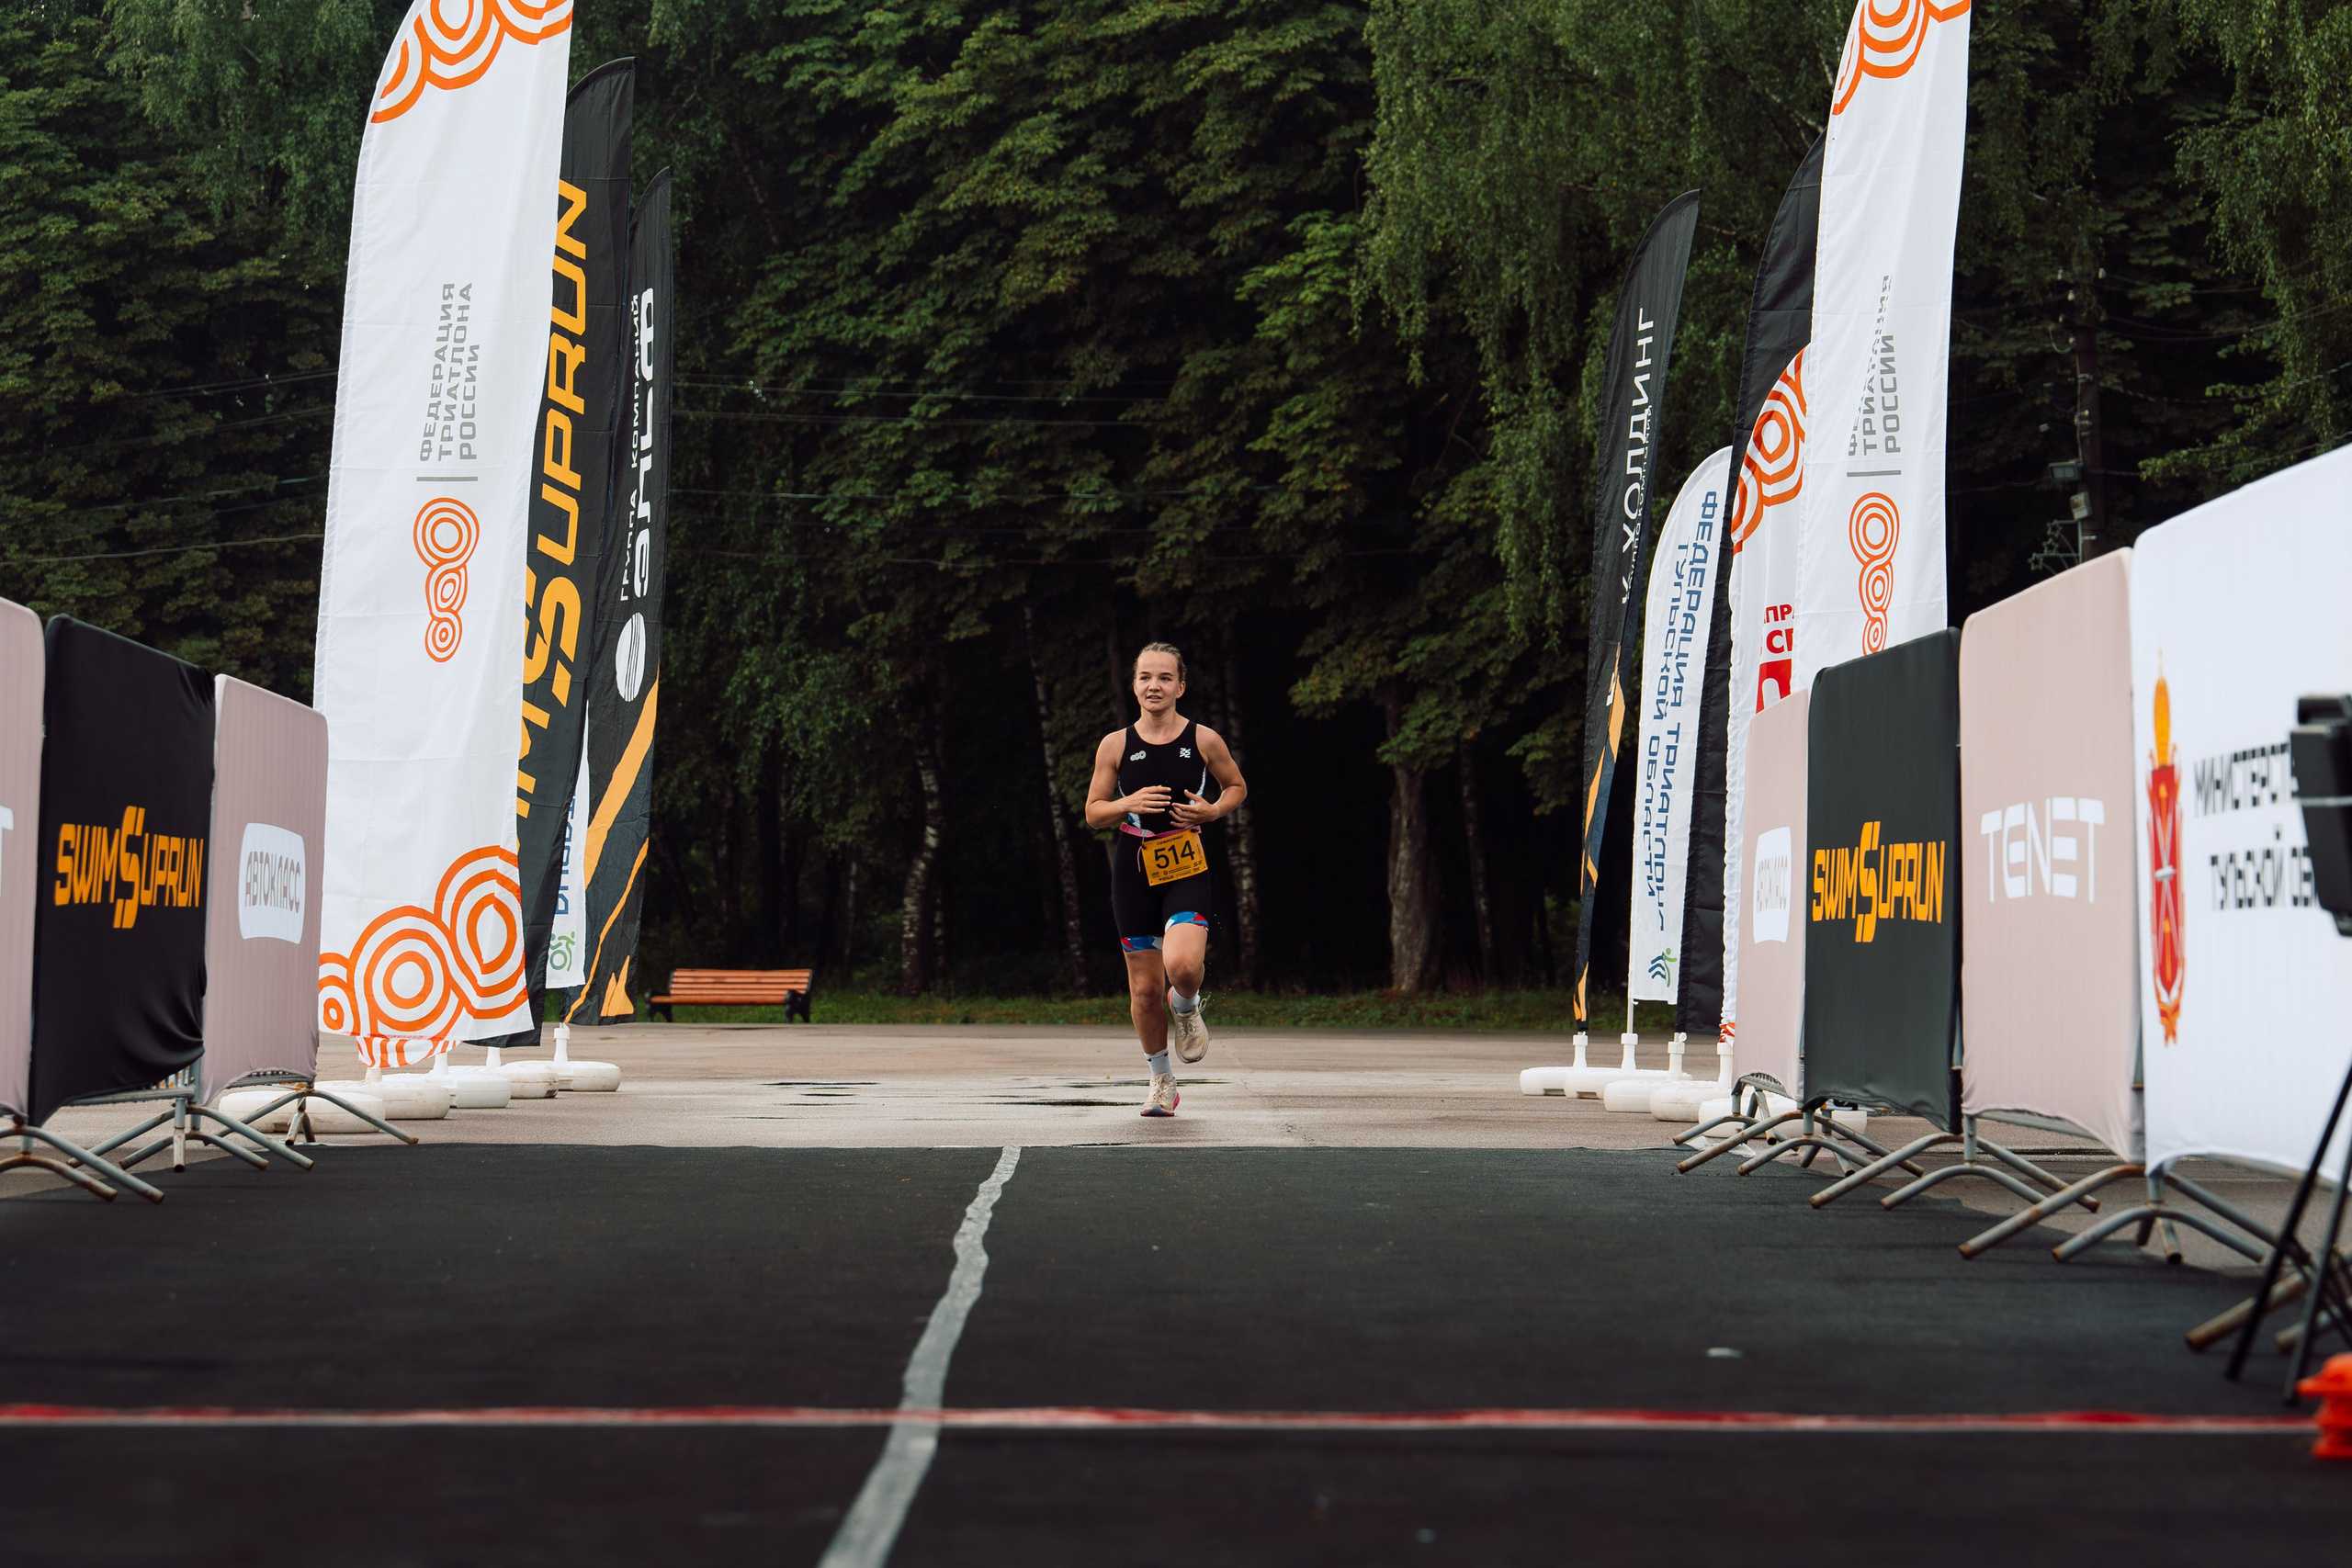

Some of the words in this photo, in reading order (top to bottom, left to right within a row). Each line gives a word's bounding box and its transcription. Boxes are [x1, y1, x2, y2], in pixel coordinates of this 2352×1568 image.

[420, 283, 455, 461] ФЕДЕРАЦИЯ
[438, 283, 472, 461] ТРИАТЛОНА
[459, 344, 481, 460] РОССИИ
[1880, 335, 1901, 453] РОССИИ
[634, 288, 654, 598] ЭЛЬФ
[1654, 536, 1690, 719] ТУЛЬСКОЙ
[1670, 491, 1718, 706] ФЕДЕРАЦИЯ
[55, 806, 203, 929] SWIMSUPRUN
[1154, 840, 1195, 869] 514
[1643, 735, 1660, 897] ОБЛАСТИ
[1981, 797, 2105, 903] TENET
[245, 851, 301, 913] АВТОКЛАСС
[1813, 821, 1945, 942] SWIMSUPRUN
